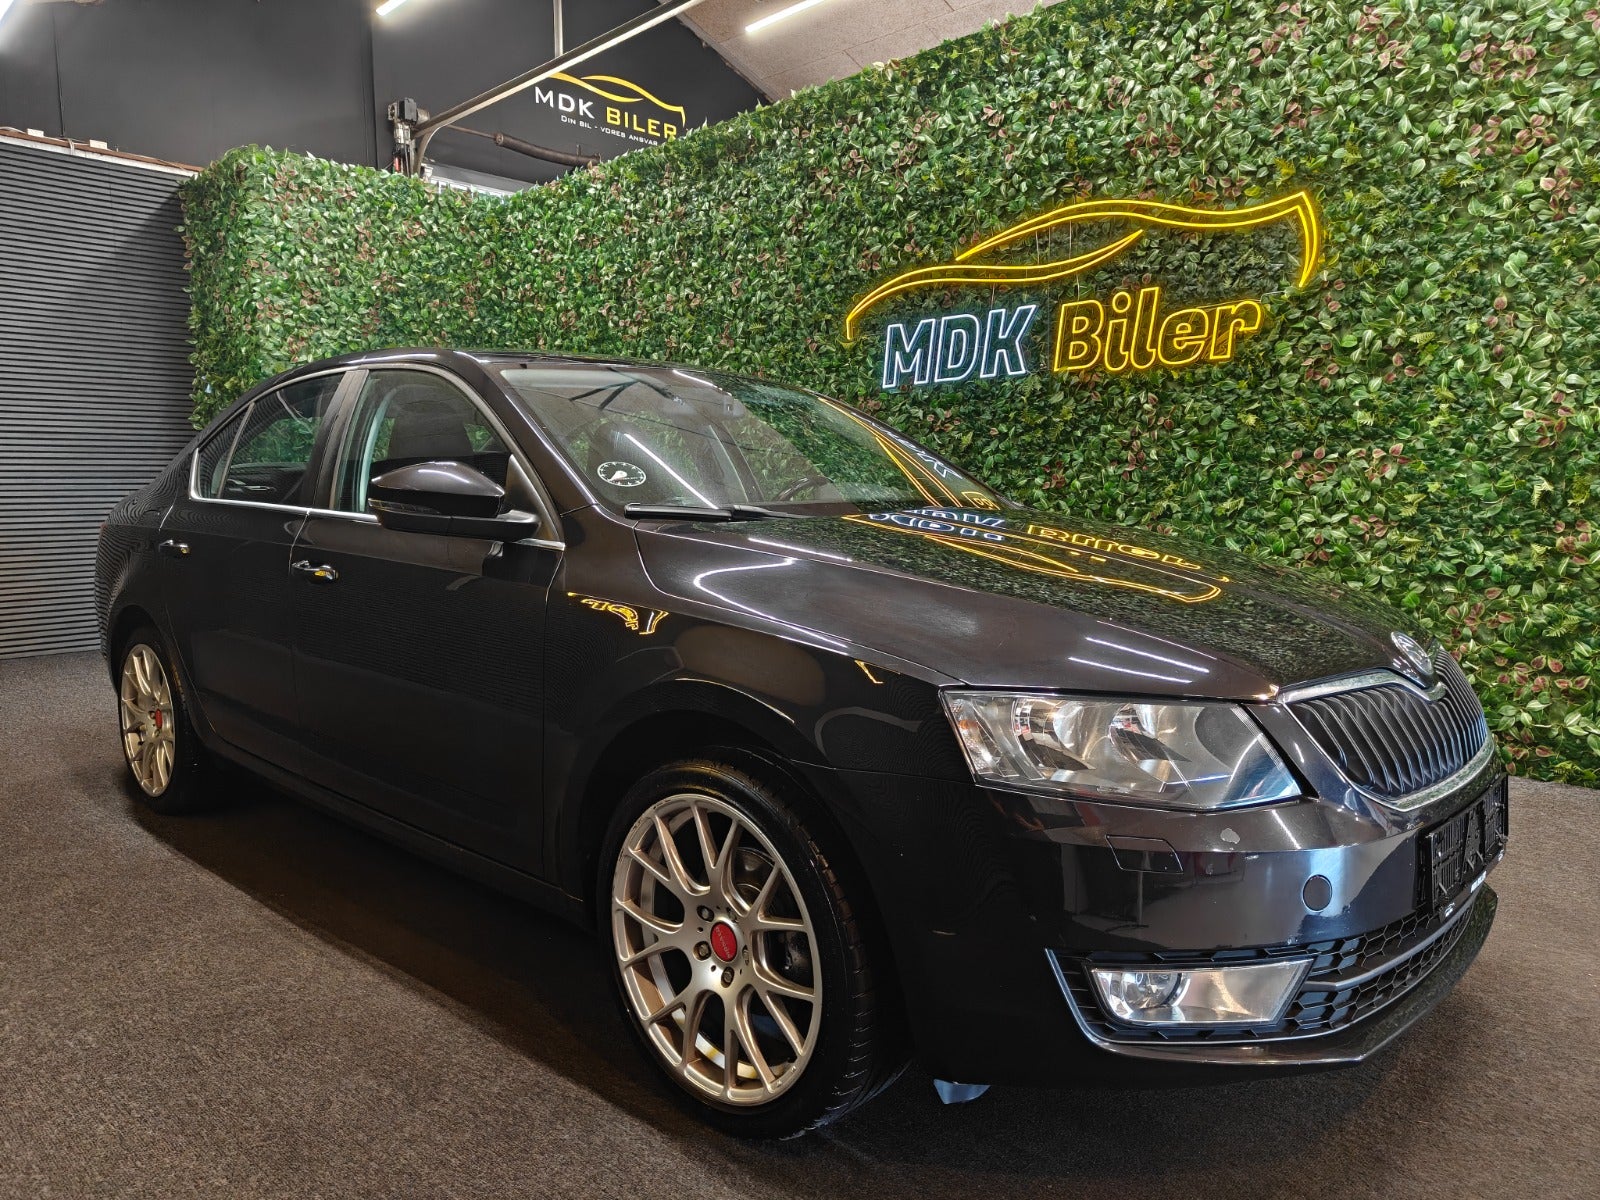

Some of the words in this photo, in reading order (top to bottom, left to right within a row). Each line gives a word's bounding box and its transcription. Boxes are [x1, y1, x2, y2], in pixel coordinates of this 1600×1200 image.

[535, 86, 595, 119] MDK
[606, 106, 677, 140] BILER
[882, 304, 1037, 389] MDK
[1053, 286, 1263, 373] Biler
